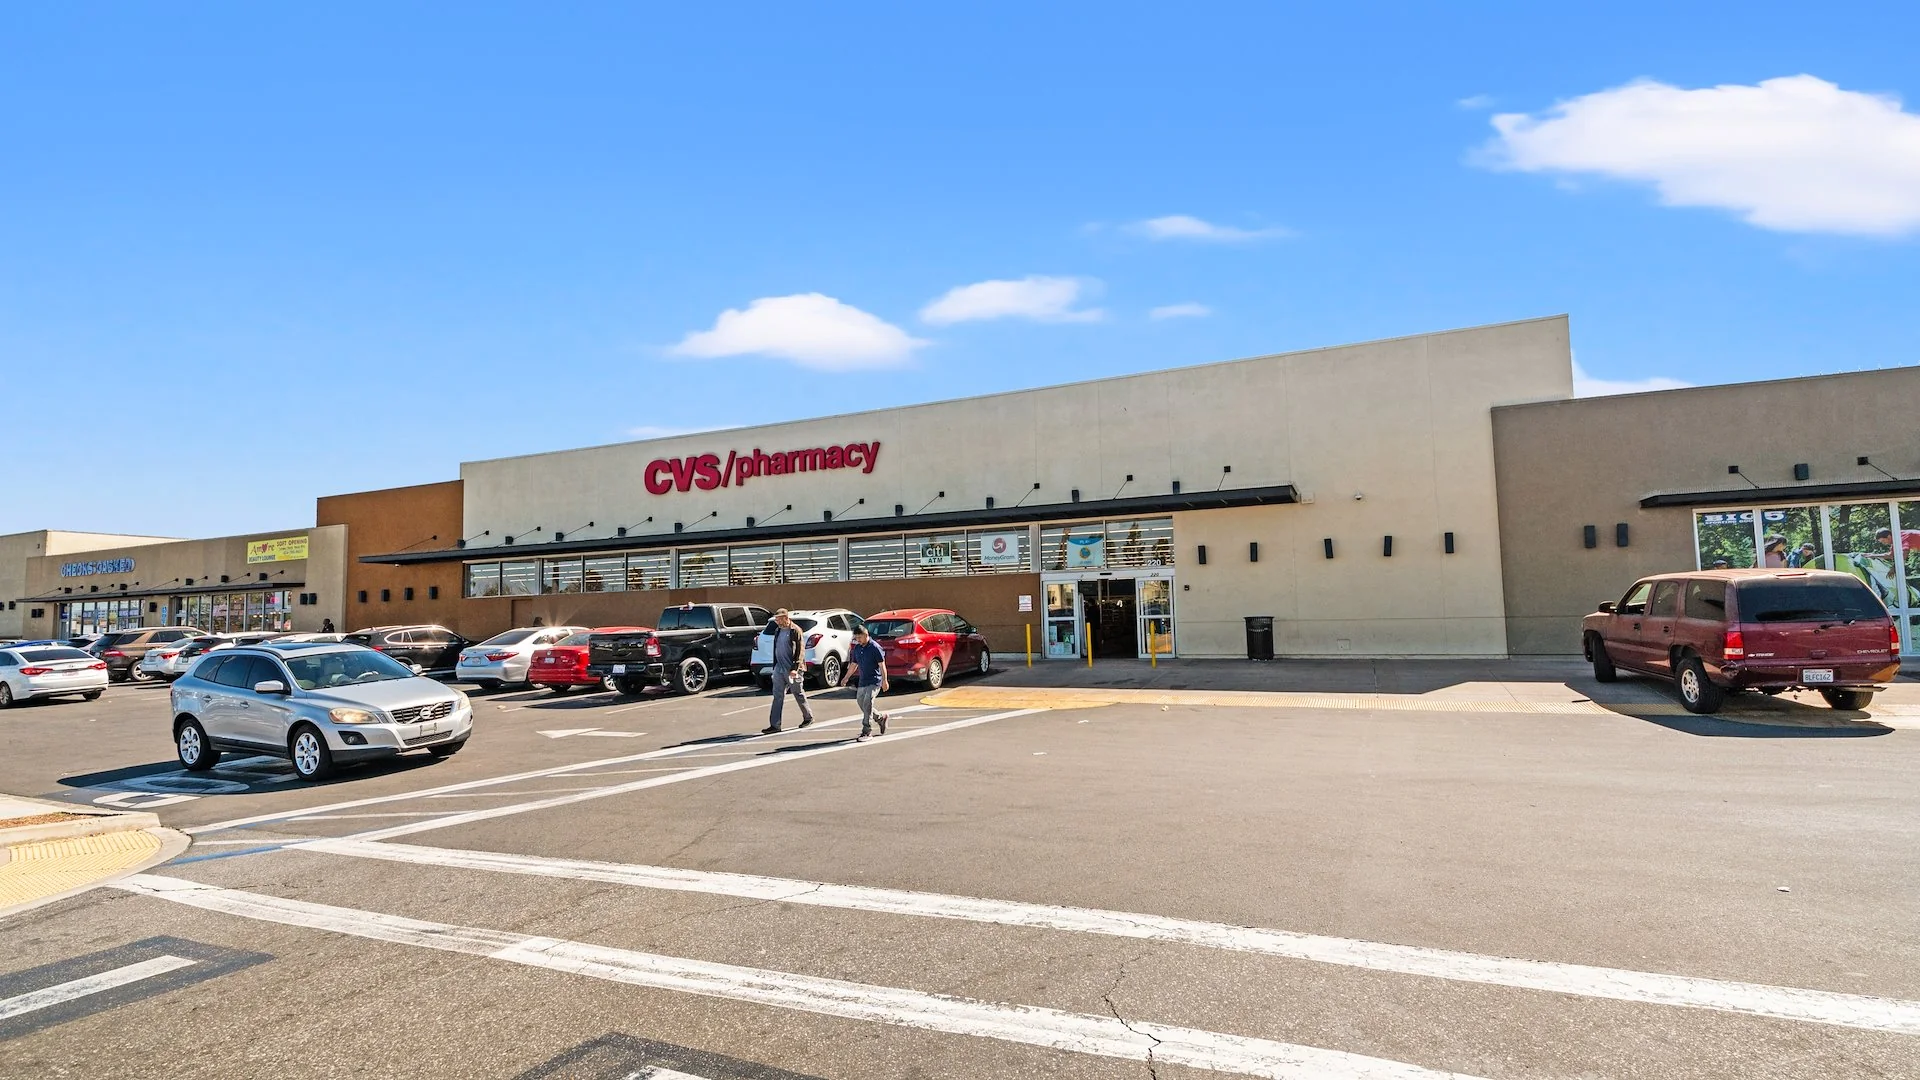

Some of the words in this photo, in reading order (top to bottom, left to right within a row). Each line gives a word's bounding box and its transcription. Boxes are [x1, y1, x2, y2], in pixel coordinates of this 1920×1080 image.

[644, 441, 881, 496] CVS/pharmacy
[1764, 510, 1786, 521] 5
[926, 545, 944, 557] citi
